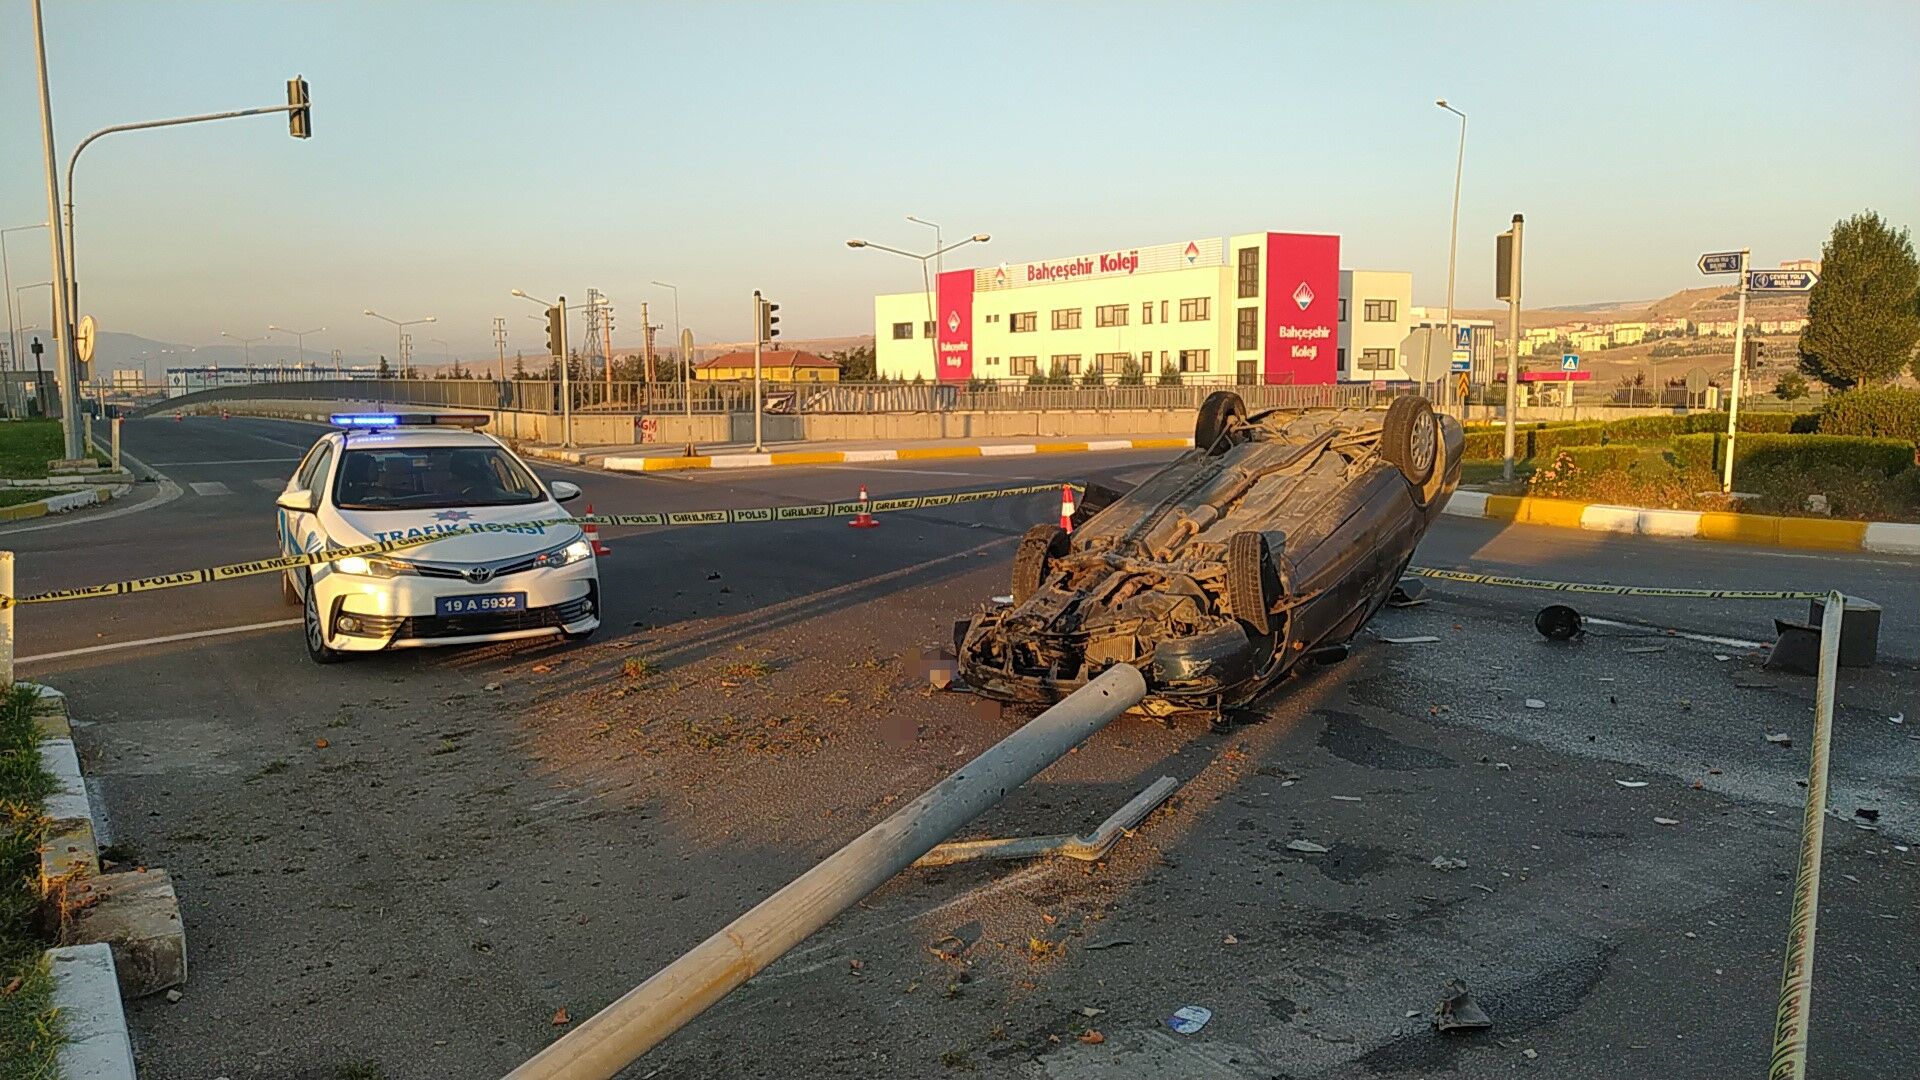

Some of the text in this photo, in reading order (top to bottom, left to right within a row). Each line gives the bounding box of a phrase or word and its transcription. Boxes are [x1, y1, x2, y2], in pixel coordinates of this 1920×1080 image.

[1027, 250, 1139, 281] Bahçeşehir Koleji
[1279, 325, 1331, 341] Bahçeşehir
[1291, 345, 1317, 361] Koleji
[444, 596, 516, 612] 19 A 5932
